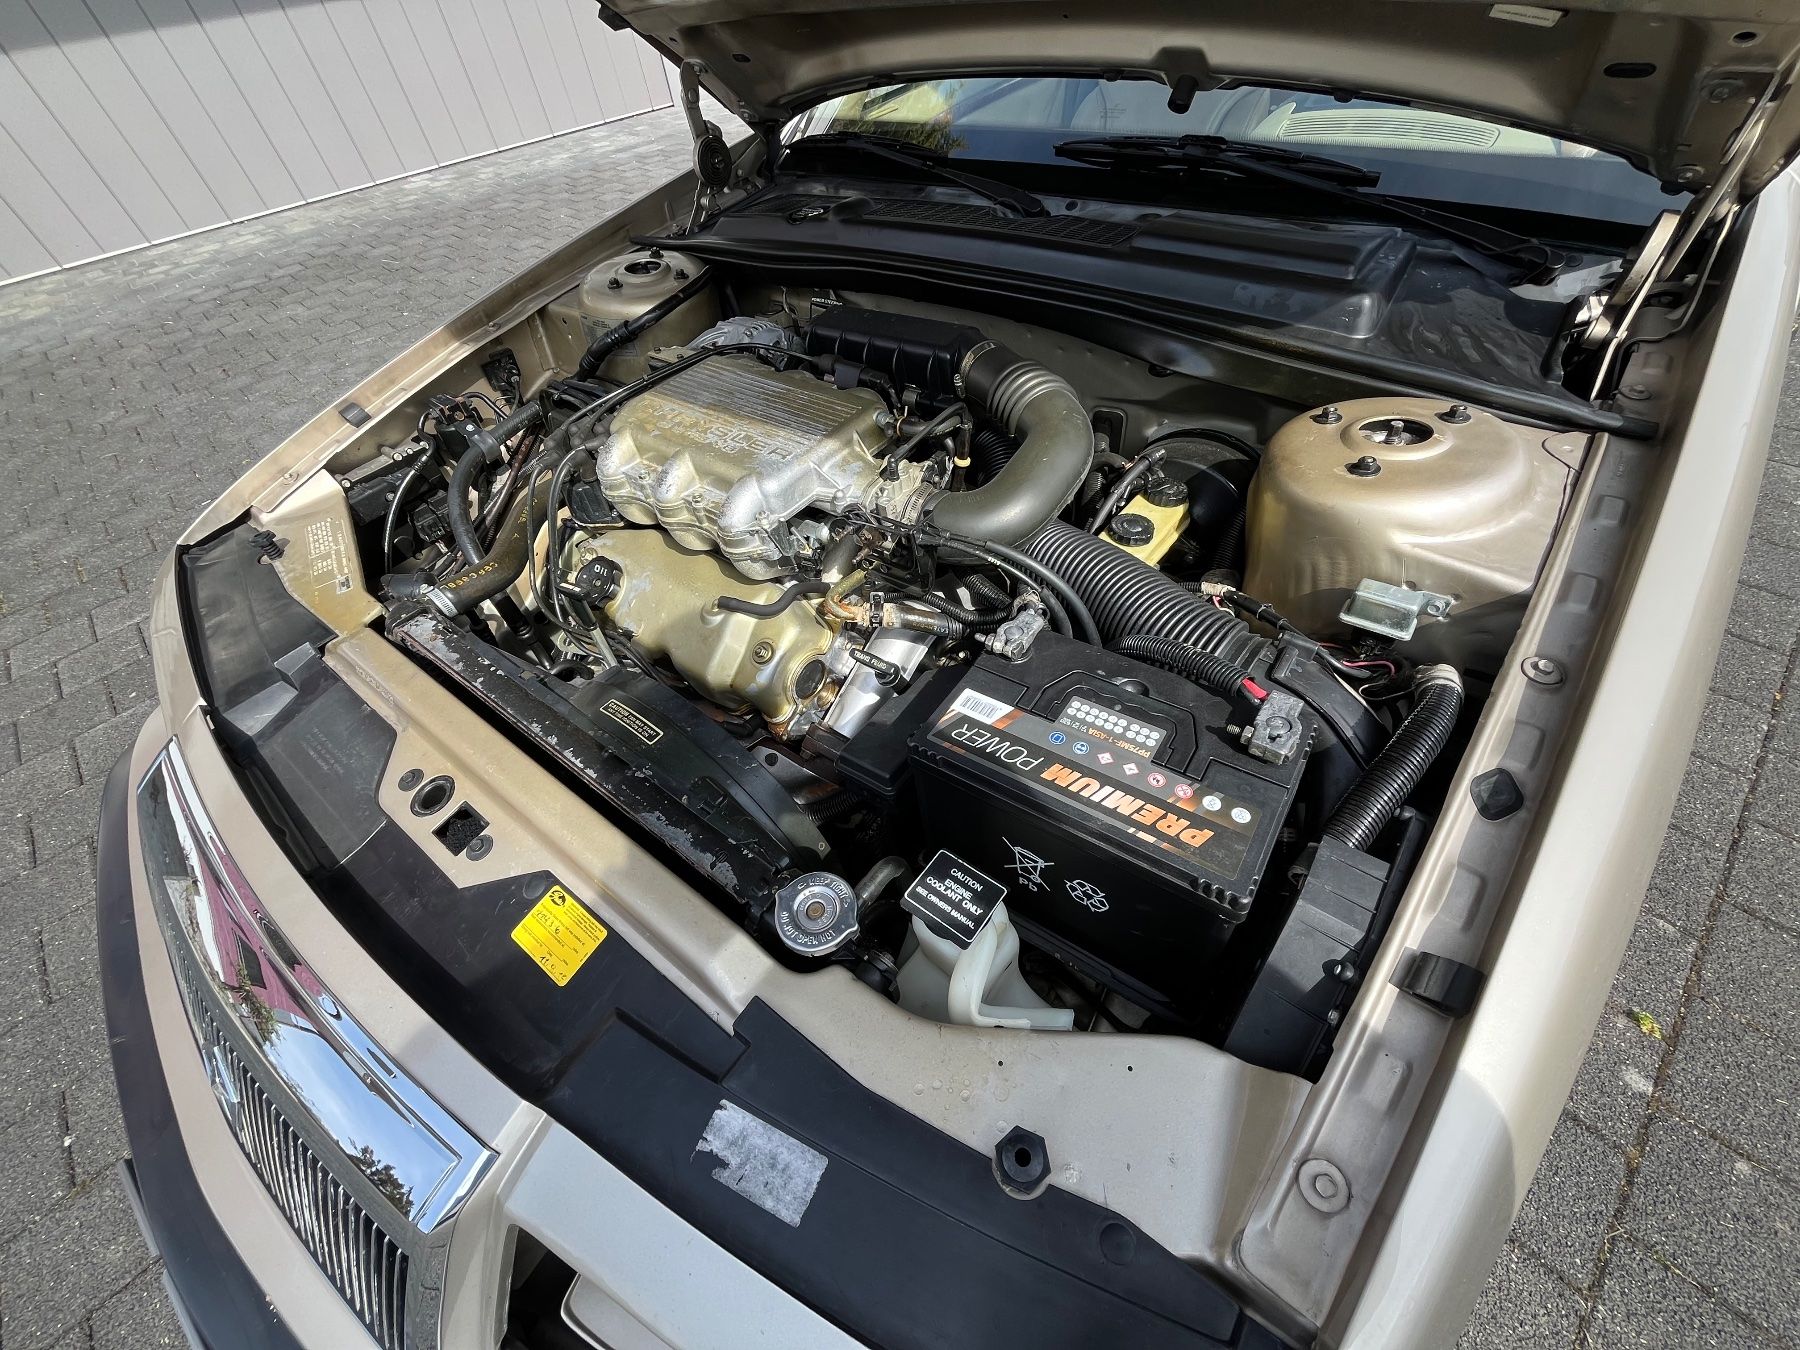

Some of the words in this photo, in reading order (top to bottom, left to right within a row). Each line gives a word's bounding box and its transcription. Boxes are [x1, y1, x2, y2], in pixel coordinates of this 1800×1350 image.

[594, 564, 608, 576] OIL
[951, 723, 1045, 772] POWER
[1040, 763, 1215, 848] PREMIUM
[926, 876, 962, 903] COOLANT
[962, 900, 984, 916] ONLY
[944, 878, 973, 900] ENGINE
[950, 868, 983, 892] CAUTION
[1018, 876, 1038, 892] Pb
[915, 885, 928, 898] SEE
[950, 909, 975, 930] MANUAL
